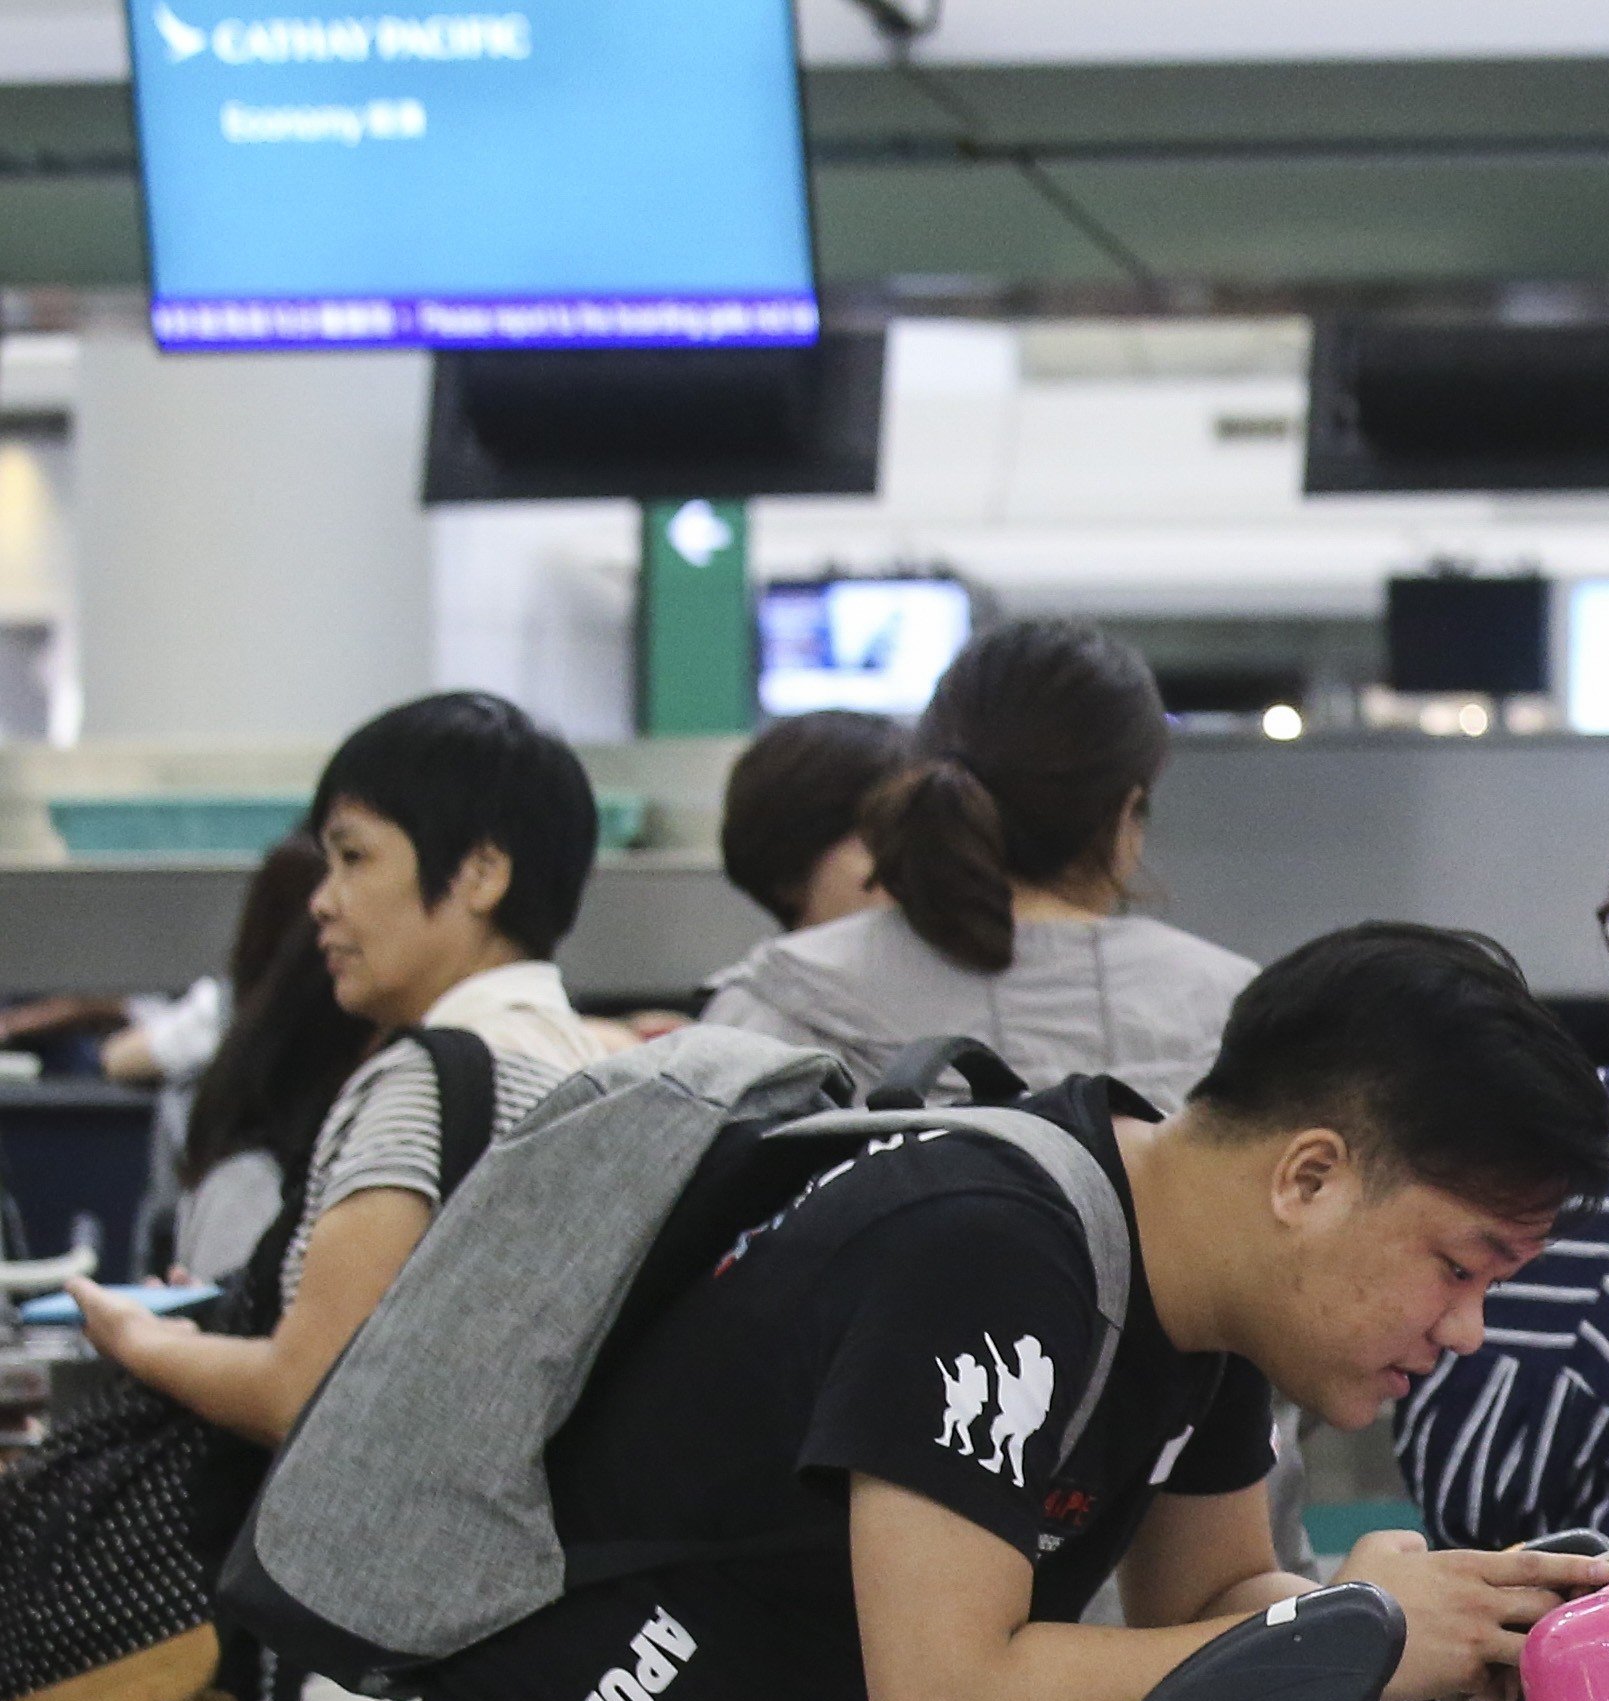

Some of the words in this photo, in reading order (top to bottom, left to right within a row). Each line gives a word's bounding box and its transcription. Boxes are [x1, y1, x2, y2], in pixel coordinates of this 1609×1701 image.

[212, 17, 370, 65] CATHAY
[375, 12, 532, 62] PACIFIC
[220, 99, 365, 148] Economy
